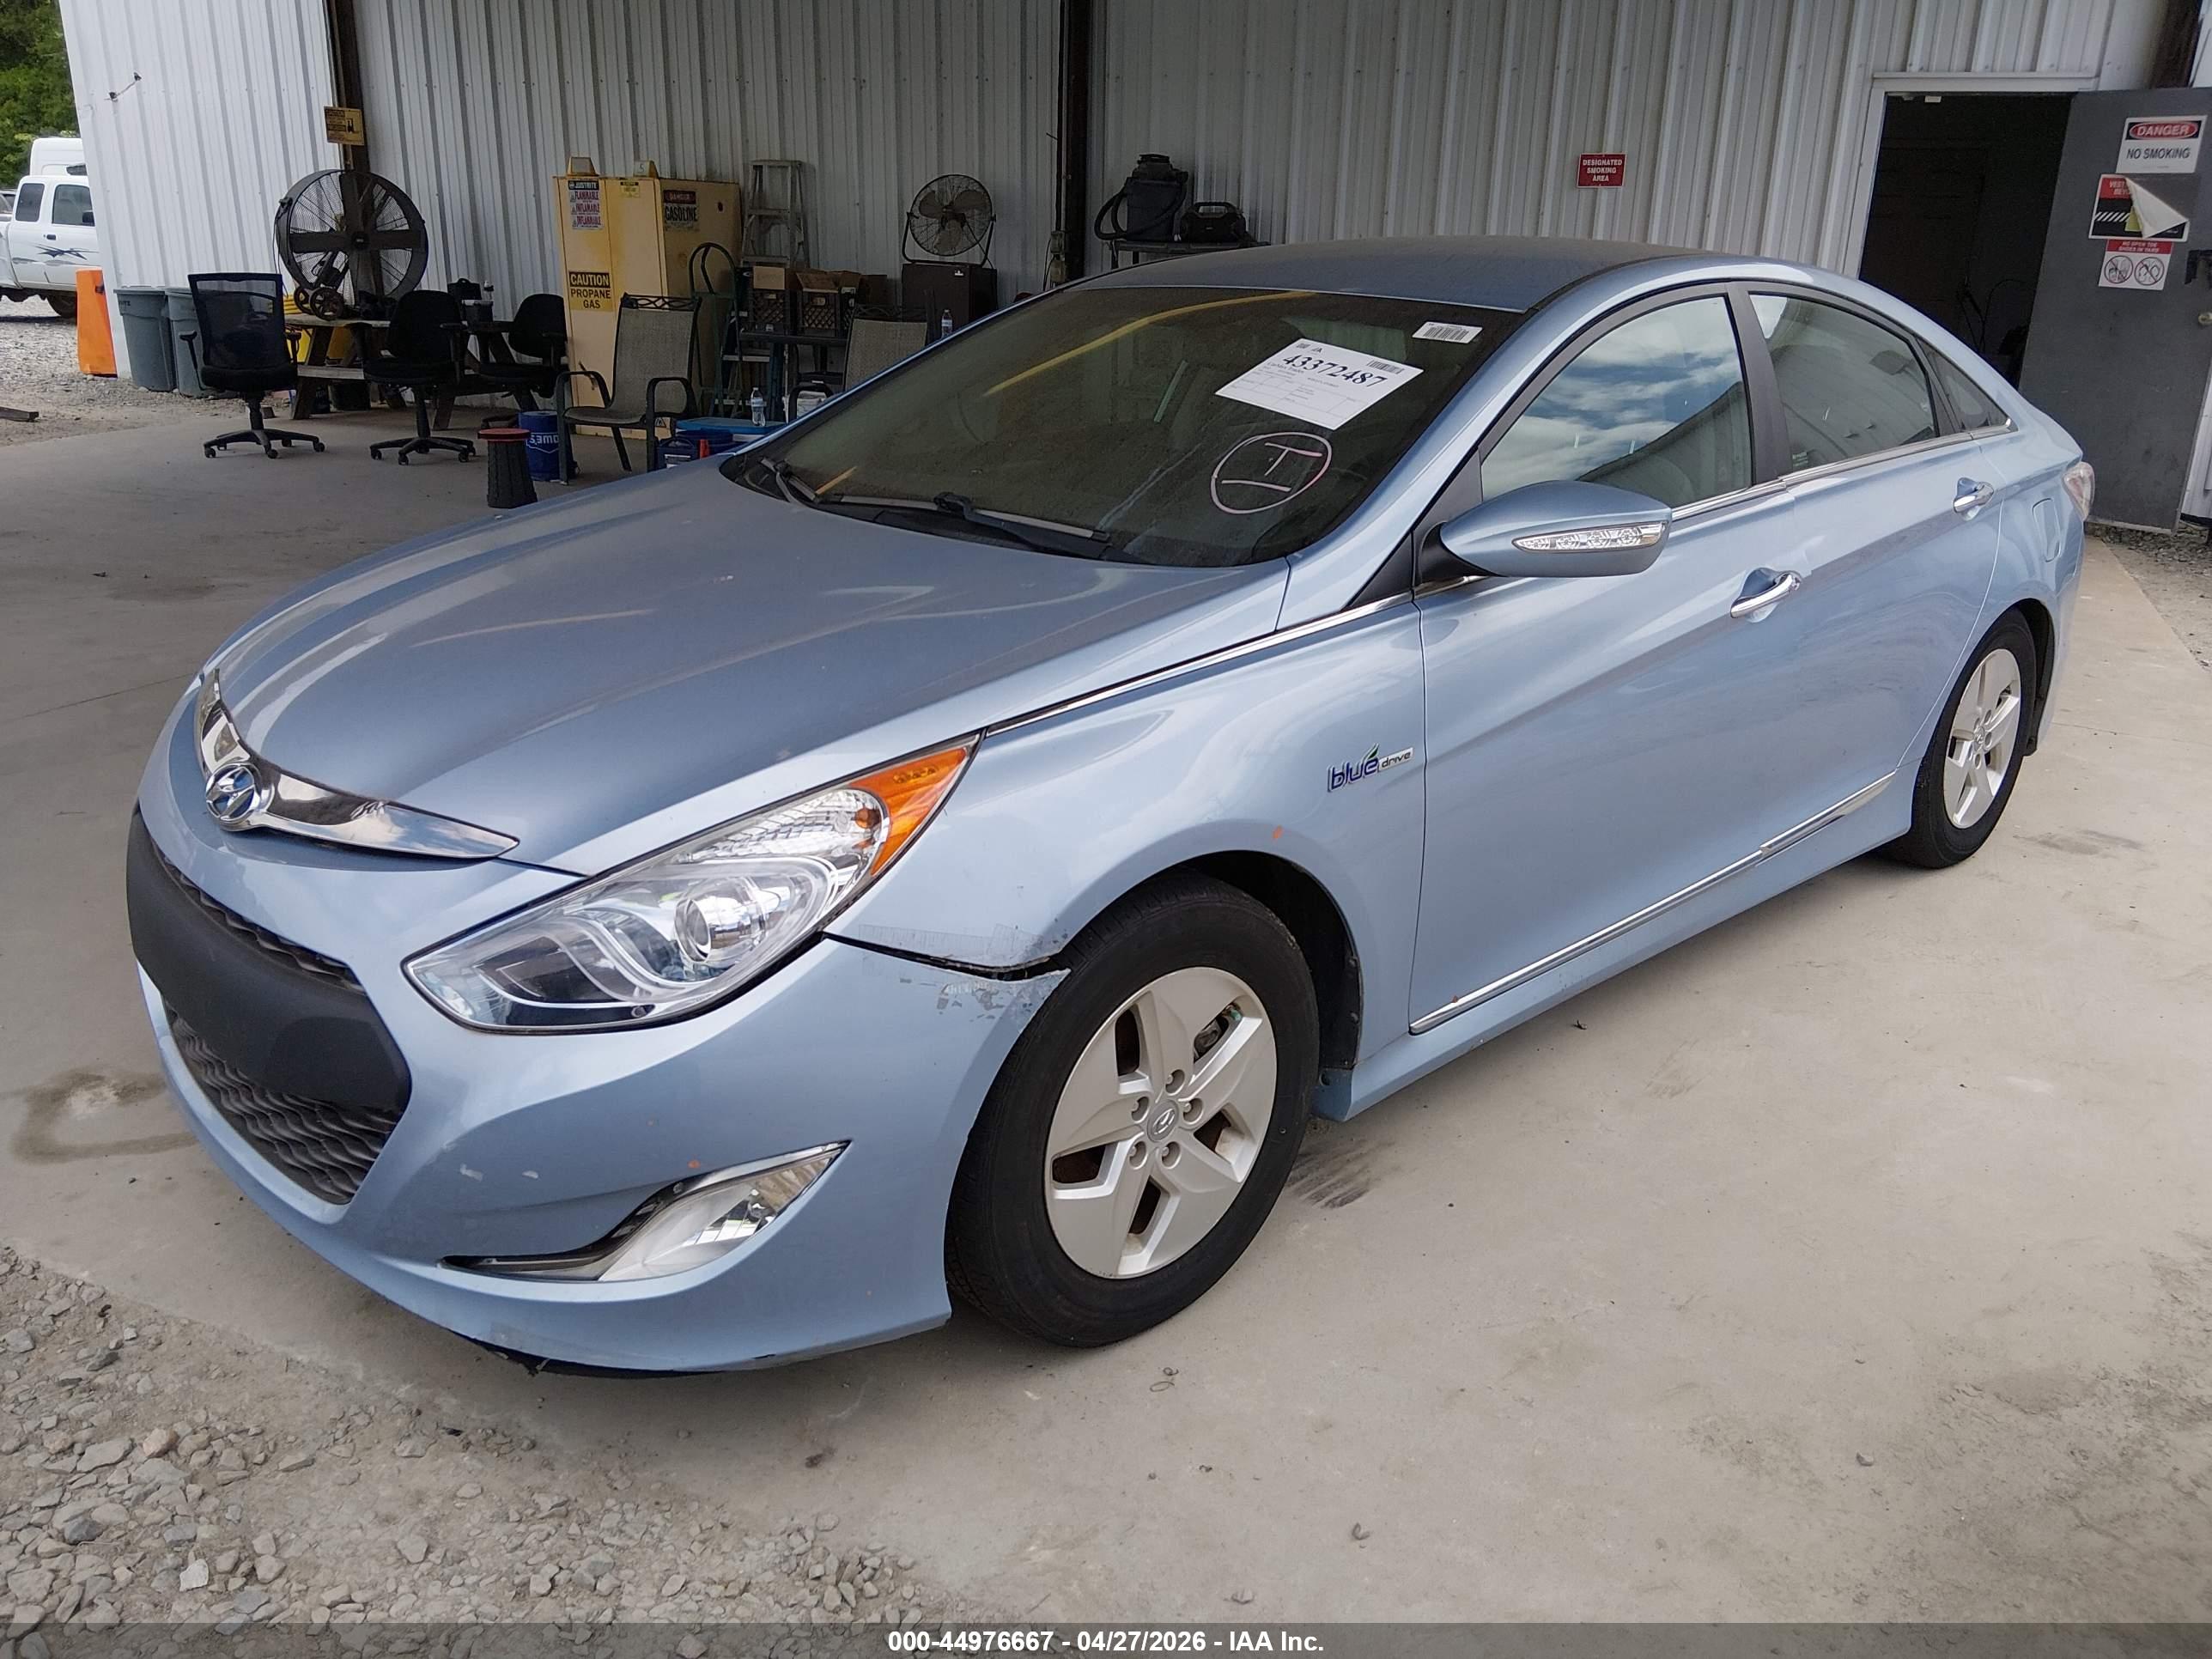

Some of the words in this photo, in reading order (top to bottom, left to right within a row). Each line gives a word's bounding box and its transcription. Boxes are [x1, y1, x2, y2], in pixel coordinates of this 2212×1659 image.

[2136, 125, 2190, 137] DANGER
[2126, 148, 2142, 159] NO
[2143, 148, 2191, 160] SMOKING
[575, 191, 599, 200] FLAMMABLE
[665, 206, 699, 222] GASOLINE
[570, 274, 609, 286] CAUTION
[570, 289, 611, 299] PROPANE
[583, 299, 601, 309] GAS
[1283, 355, 1388, 387] 43372487
[529, 434, 559, 446] OWE'S
[1330, 757, 1379, 791] blue
[1381, 752, 1412, 769] drive
